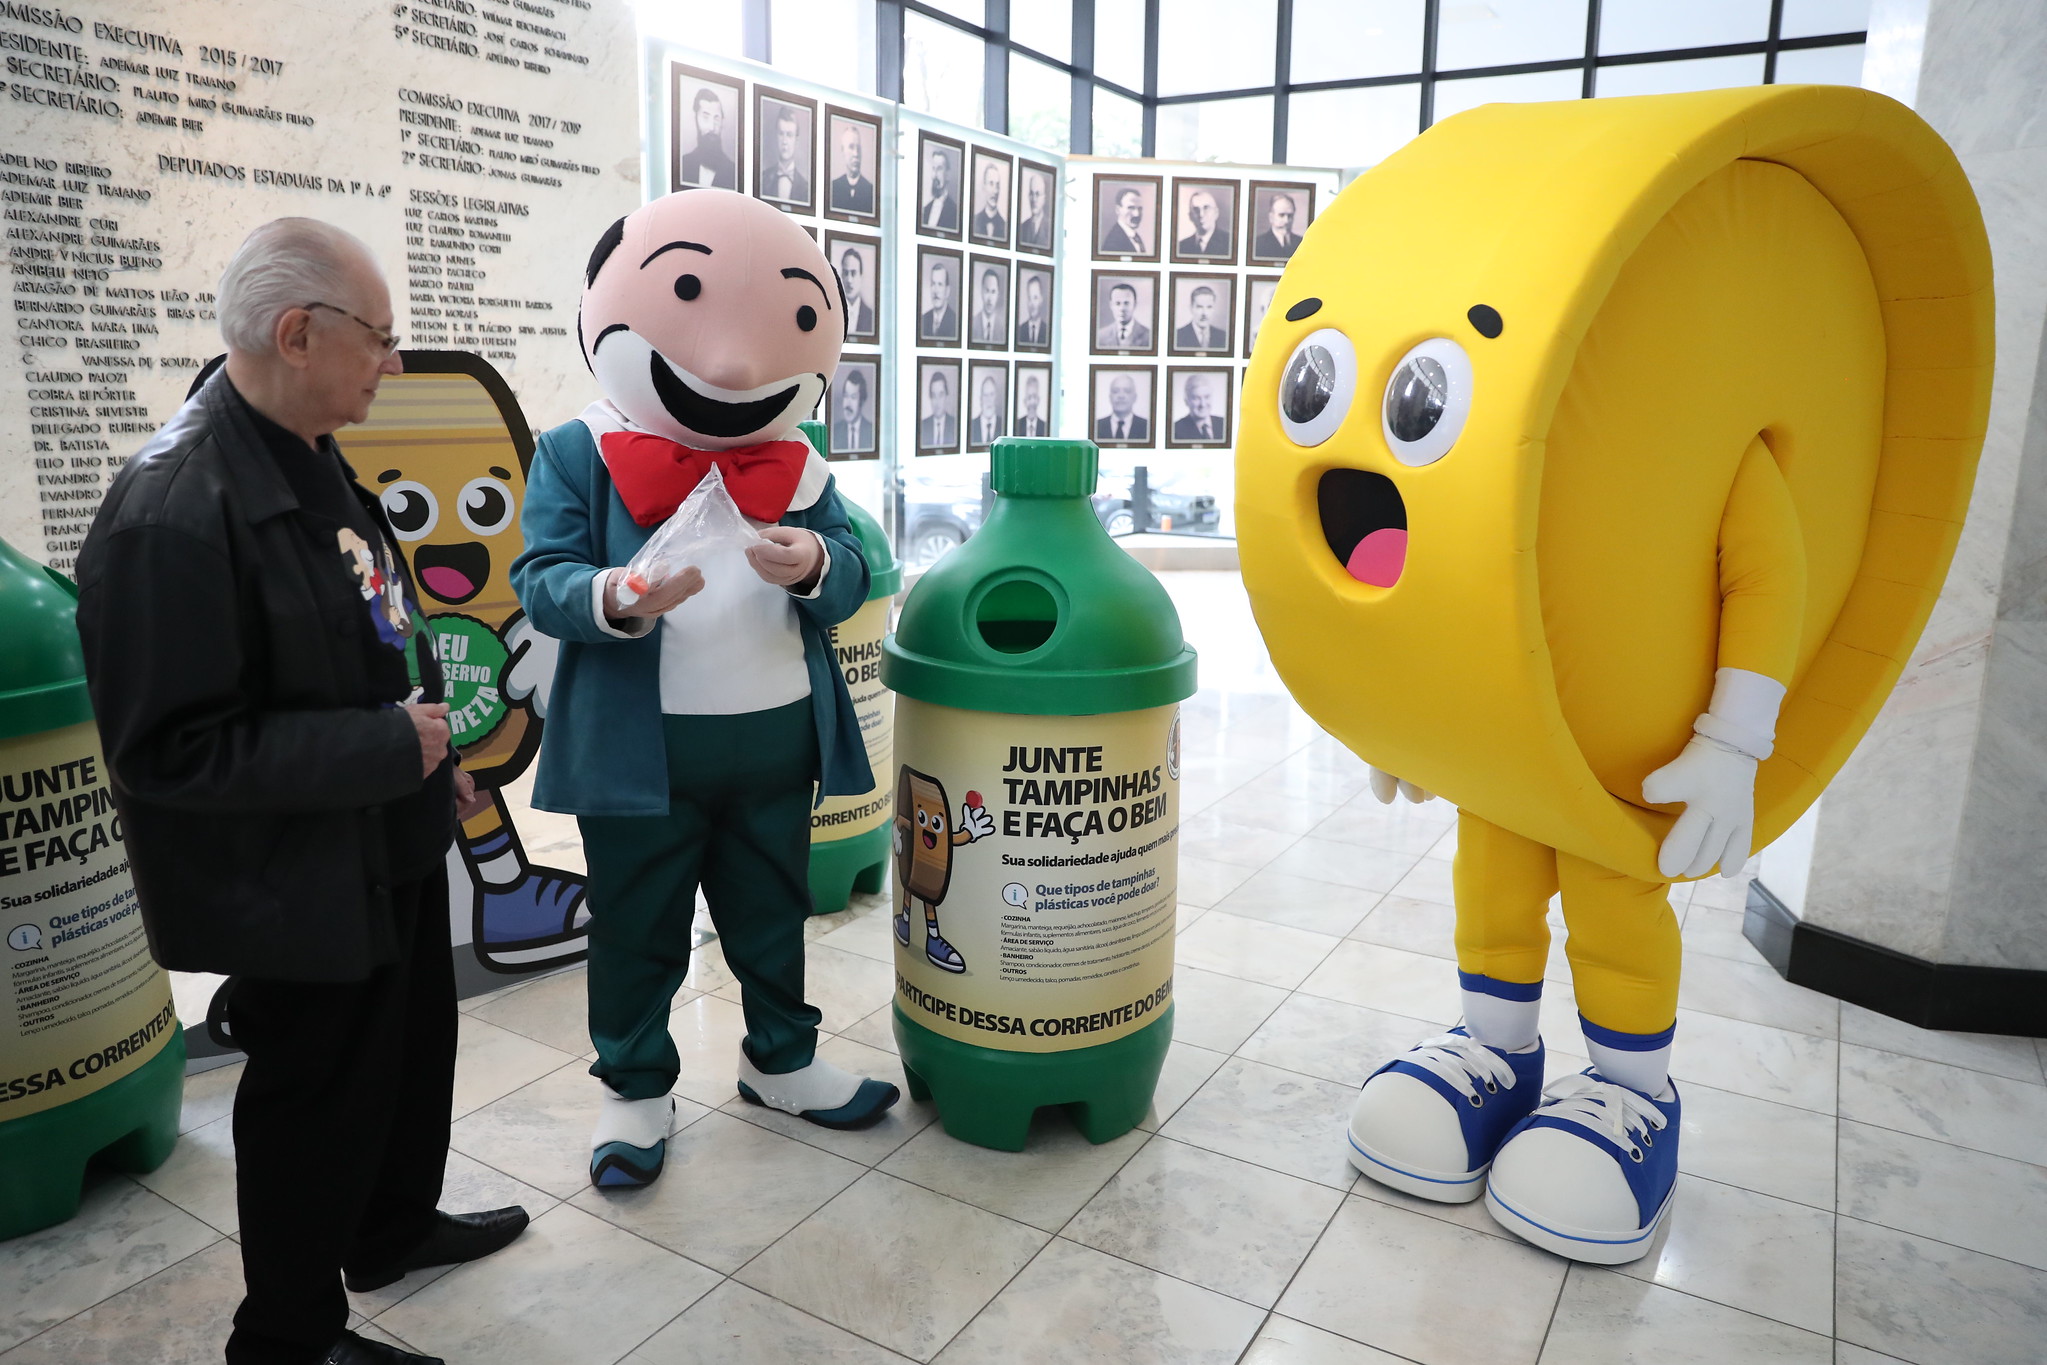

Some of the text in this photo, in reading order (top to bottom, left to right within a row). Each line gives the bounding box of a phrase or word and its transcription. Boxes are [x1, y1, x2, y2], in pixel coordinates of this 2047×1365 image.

[411, 8, 478, 37] SECRETÁRIO:
[94, 22, 183, 56] EXECUTIVA
[200, 46, 237, 67] 2015
[250, 56, 284, 76] 2017
[412, 29, 480, 58] SECRETÁRIO:
[0, 31, 236, 91] ESIDENTE: ADEMAR LUIZ TRAIANO
[6, 55, 314, 127] SECRETÁRIO: PLAUTO MIRÓ GUIMARÃES FILHO
[11, 82, 204, 131] SECRETÁRIO: ADEMIR BIER
[398, 88, 463, 112] COMISSÃO
[467, 101, 520, 123] EXECUTIVA
[528, 113, 551, 129] 2017
[399, 108, 462, 133] PRESIDENTE:
[418, 132, 484, 155] SECRETÁRIO:
[65, 162, 112, 178] RIBEIRO
[419, 153, 485, 175] SECRETÁRIO:
[0, 171, 151, 200] ADEMAR LUIZ TRAIANO
[158, 153, 245, 181] DEPUTADOS
[253, 168, 322, 191] ESTADUAIS
[328, 178, 345, 193] DA
[410, 189, 458, 208] SESSÕES
[1, 189, 83, 209] ADEMIR BIER
[4, 208, 118, 232] ALEXANDRE CURI
[6, 228, 160, 251] ALEXANDRE GUIMARÃES
[11, 264, 109, 281] ANIBELLI NETO
[120, 255, 162, 269] BUENO
[13, 281, 189, 302] ARTAGÃO DE MATTOS LEÃO
[14, 300, 195, 319] BERNARDO GUIMARÃES RIBAS
[18, 318, 159, 335] CANTORA MARA LIMA
[20, 335, 140, 350] CHICO BRASILEIRO
[82, 355, 135, 368] VANESSA
[139, 357, 152, 369] DE
[160, 357, 199, 368] SOUZA
[26, 372, 128, 383] CLAUDIO PALOZI
[28, 386, 136, 401] COBRA REPÓRTER
[30, 406, 148, 418] CRISTINA SILVESTRI
[32, 423, 101, 435] DELEGADO
[109, 422, 156, 433] RUBENS
[34, 440, 109, 451] DR. BATISTA
[71, 457, 102, 468] LINO
[38, 474, 100, 486] EVANDRO
[40, 489, 102, 502] EVANDRO
[438, 633, 469, 662] EU
[442, 663, 491, 683] SERVO
[845, 667, 859, 685] O
[446, 686, 499, 735] REZA
[1003, 746, 1103, 773] JUNTE
[0, 756, 97, 804] UNTE
[1003, 765, 1161, 805] TAMPINHAS
[811, 798, 883, 828] ORRENTE DO
[1003, 792, 1167, 845] E FAÇA O BEM
[25, 822, 110, 872] FAÇA
[1002, 831, 1170, 867] Sua solidariedade ajuda quem mais
[1, 868, 118, 909] Sua solidariedade
[1035, 868, 1155, 897] Que tipos de tampinhas
[1035, 877, 1159, 912] plásticas você pode doar?
[49, 893, 124, 929] Que tipos de
[51, 918, 109, 948] plásticas
[109, 904, 131, 923] você
[14, 955, 50, 970] COZINHA
[1002, 967, 1027, 975] OUTROS
[18, 971, 80, 995] ÁREA DE SERVIÇO
[20, 995, 60, 1011] BANHEIRO
[896, 970, 956, 1022] PARTICIPE
[959, 1007, 1026, 1035] DESSA
[1030, 1004, 1133, 1036] CORRENTE
[1135, 993, 1154, 1018] DO
[23, 1013, 55, 1027] OUTROS
[69, 1014, 164, 1080] CORRENTE
